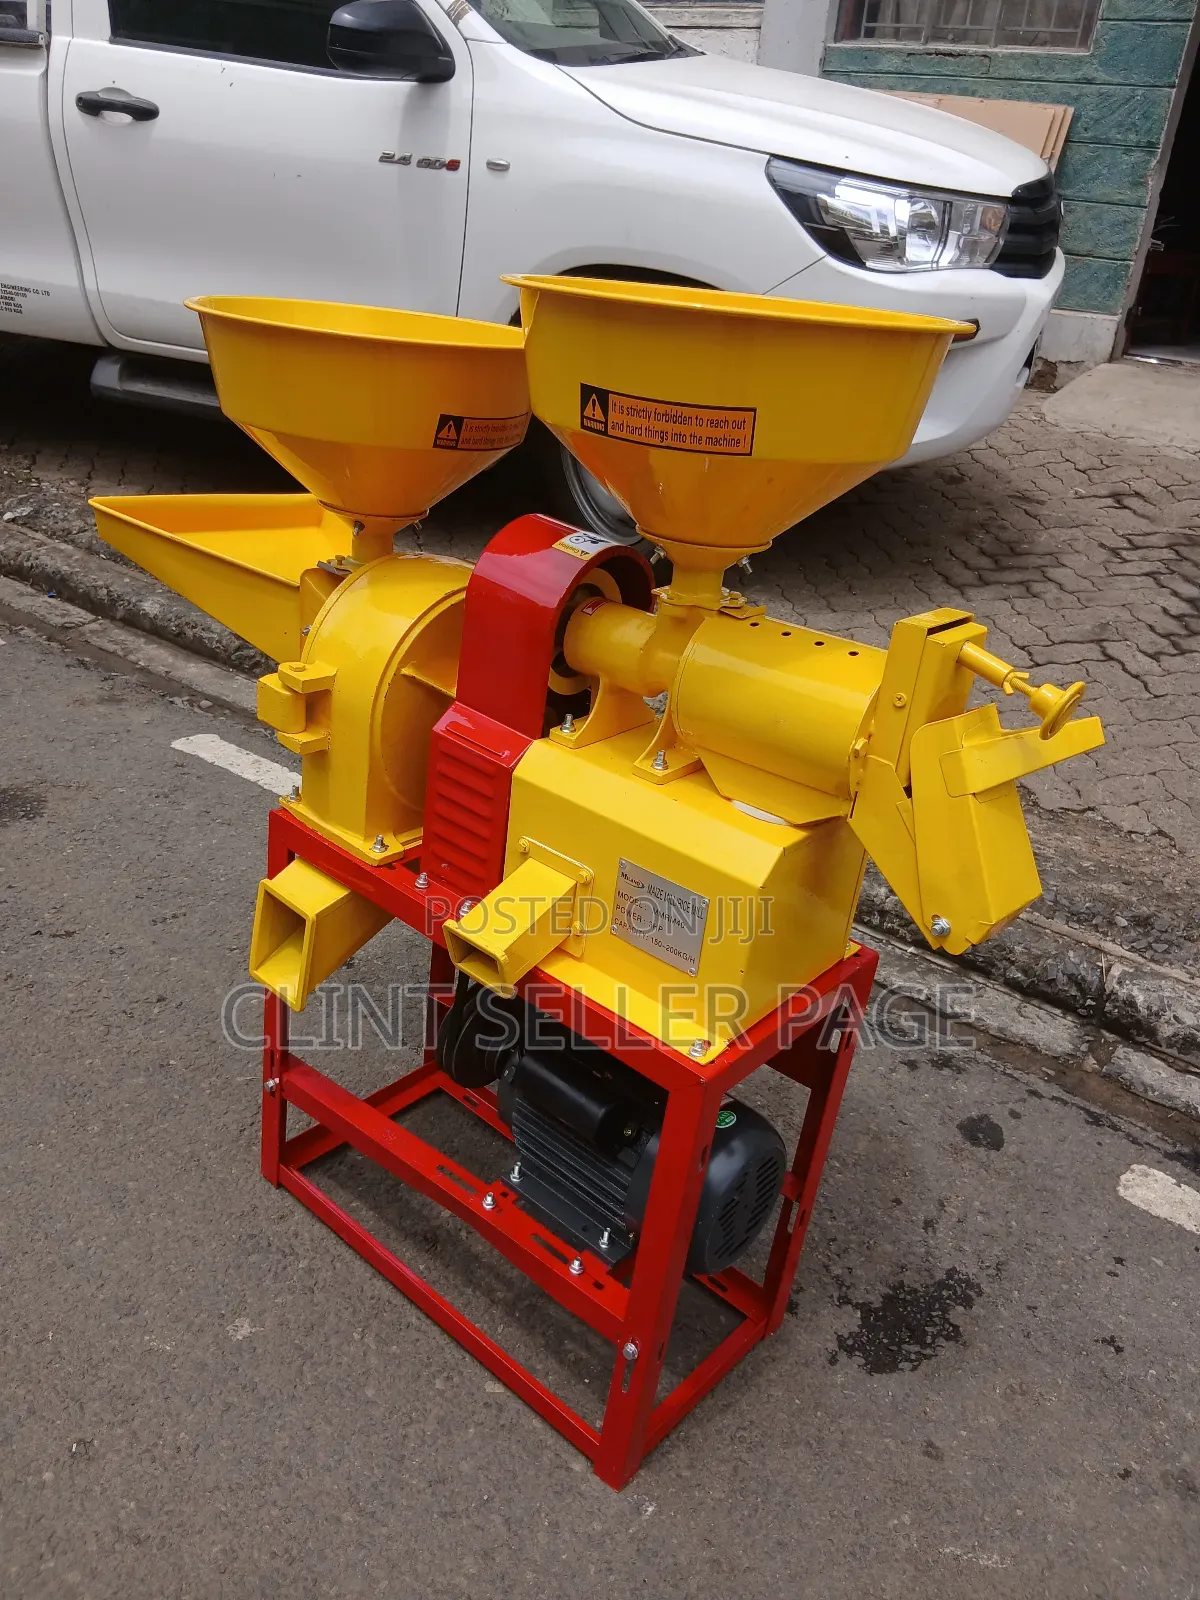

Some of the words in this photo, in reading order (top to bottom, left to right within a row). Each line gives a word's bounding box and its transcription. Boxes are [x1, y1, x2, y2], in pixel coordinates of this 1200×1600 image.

[0, 283, 31, 294] ENGINEERING
[611, 399, 617, 413] It
[618, 401, 625, 414] is
[626, 404, 652, 422] strictly
[653, 408, 693, 427] forbidden
[694, 415, 704, 427] to
[706, 415, 730, 430] reach
[731, 417, 747, 431] out
[611, 419, 625, 433] and
[625, 420, 643, 436] hard
[644, 424, 669, 443] things
[670, 428, 687, 444] into
[689, 431, 703, 446] the
[704, 434, 741, 448] machine
[647, 884, 664, 902] MAIZE
[650, 936, 696, 965] 150-200KG/H
